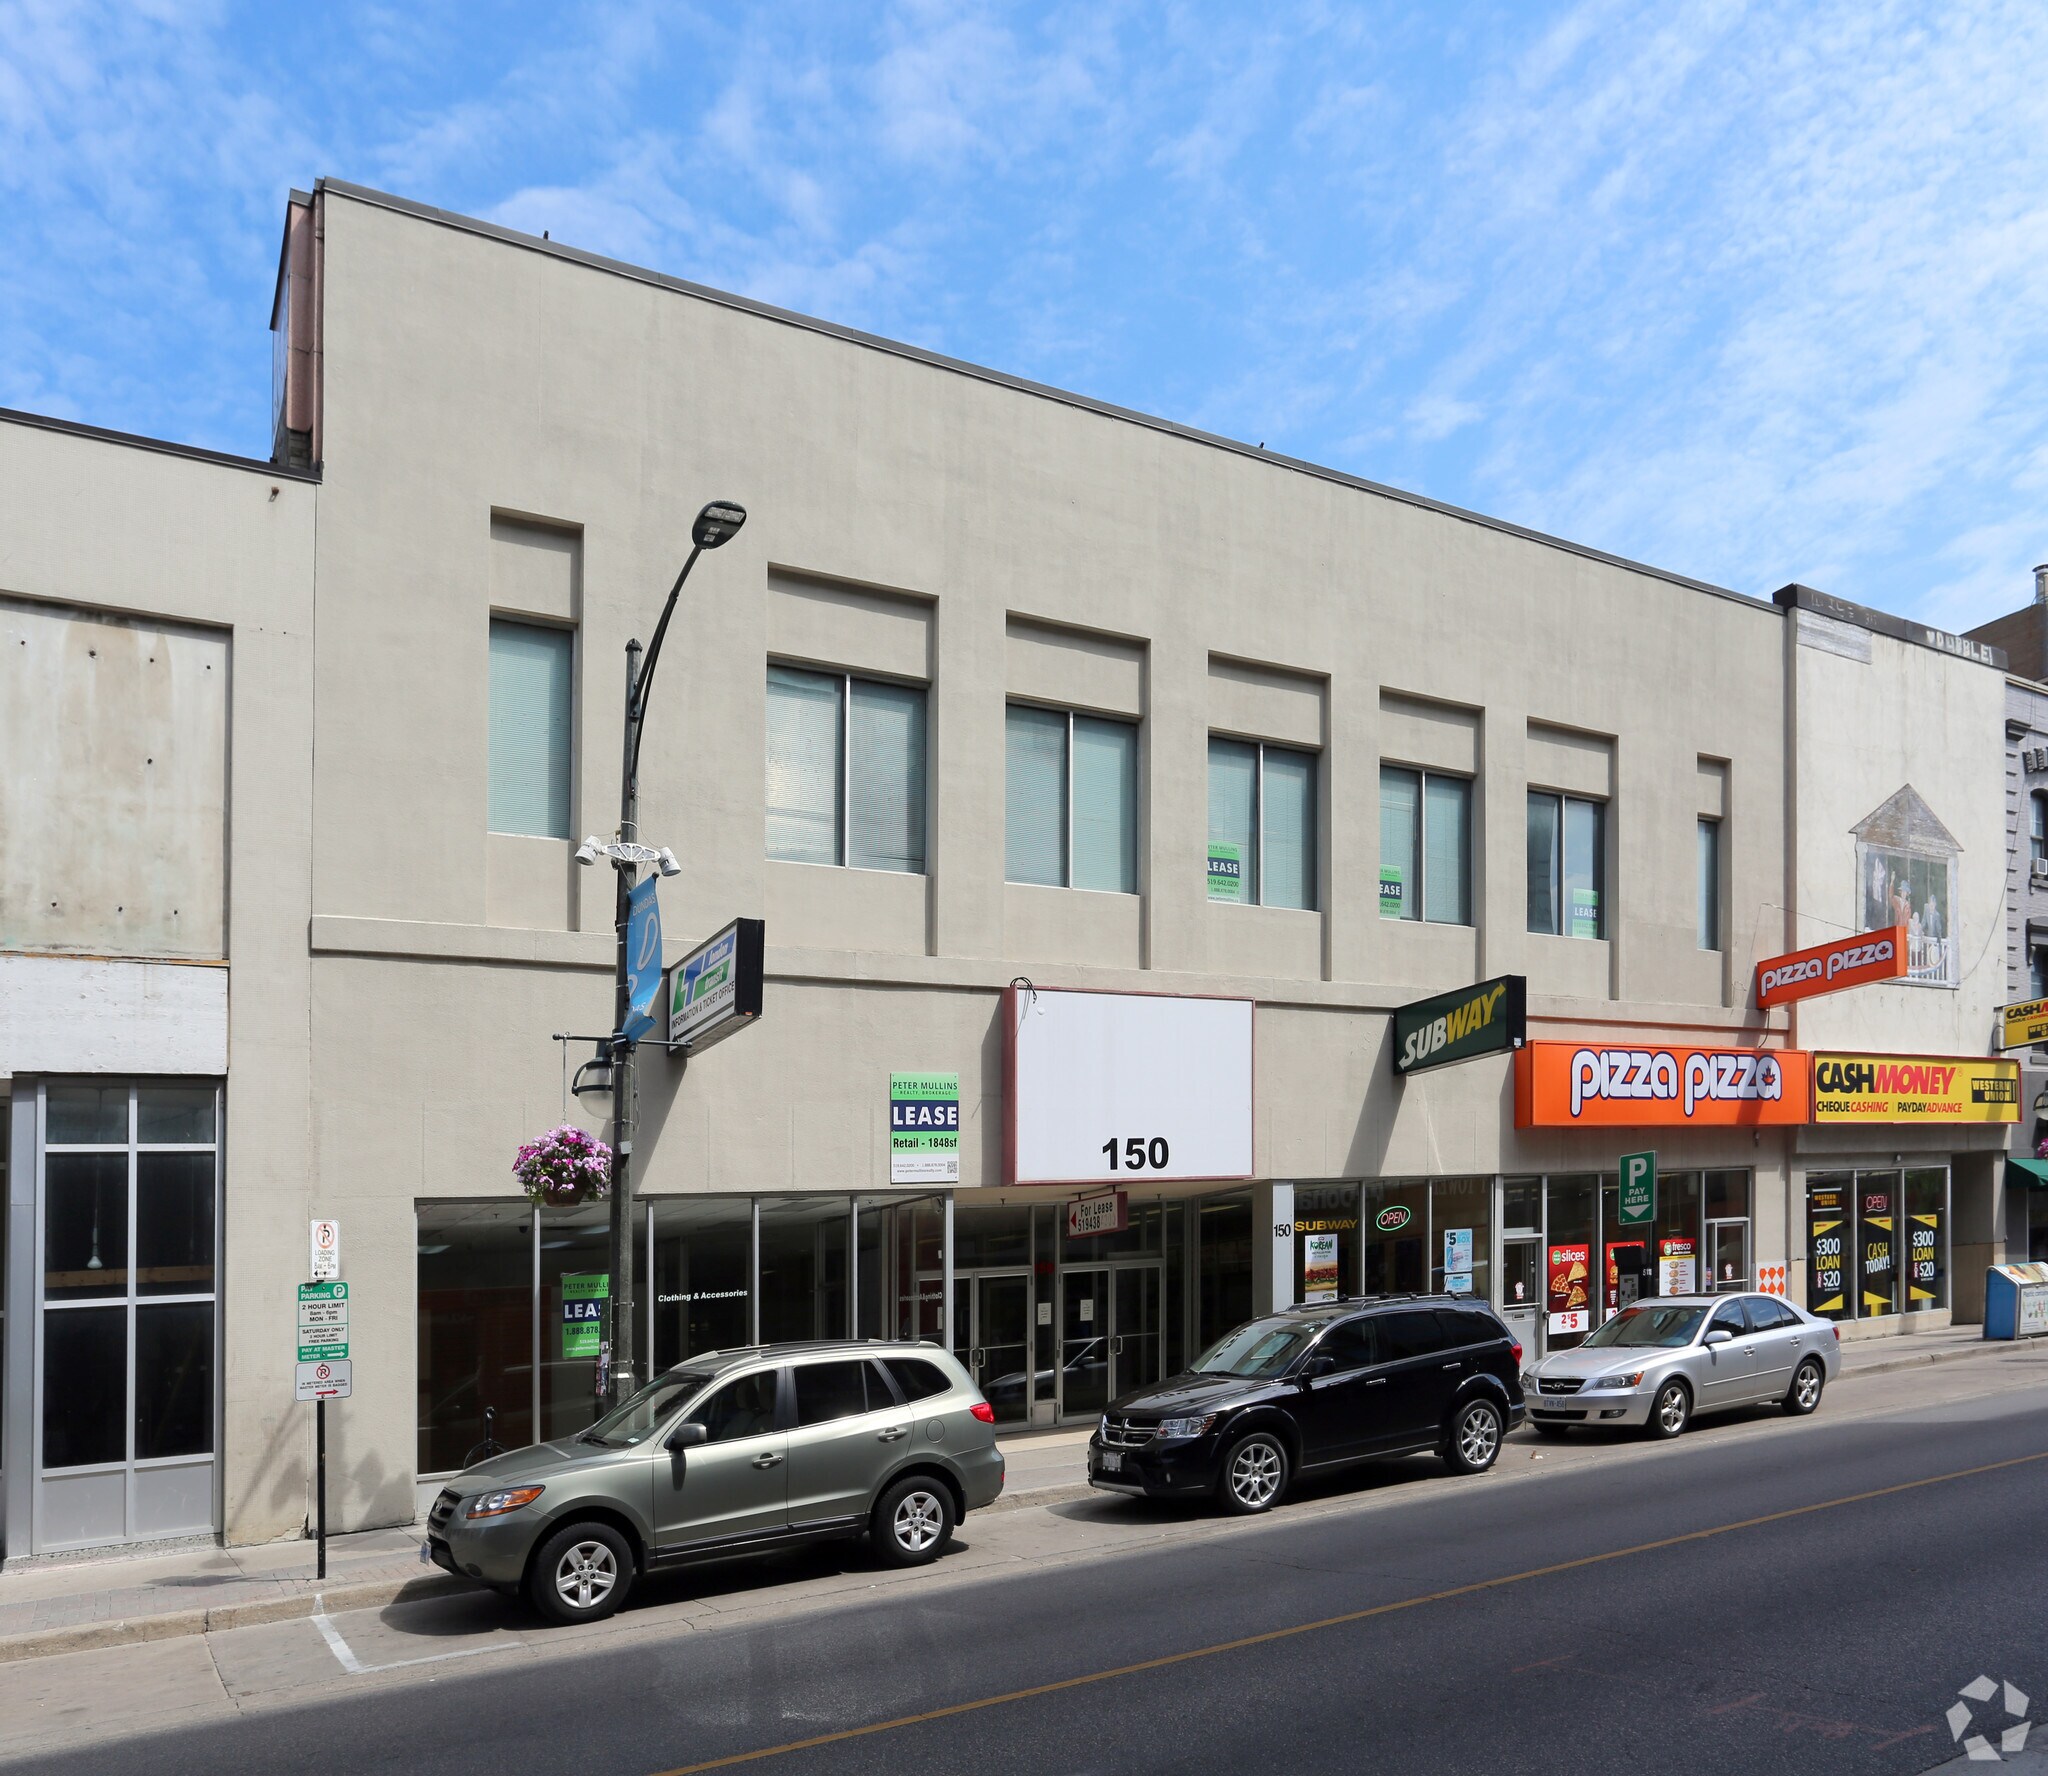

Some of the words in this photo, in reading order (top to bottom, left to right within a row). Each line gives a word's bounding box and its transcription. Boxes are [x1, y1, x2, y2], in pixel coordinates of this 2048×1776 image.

[1208, 861, 1238, 874] LEASE
[1574, 907, 1596, 918] LEASE
[1761, 958, 1823, 998] pizza
[1826, 940, 1894, 981] pizza
[672, 1004, 698, 1030] INFORMATION
[703, 991, 718, 1010] TICKET
[719, 980, 735, 1000] OFFICE
[1399, 982, 1506, 1070] SUBWAY
[892, 1082, 918, 1090] PETER
[920, 1082, 958, 1090] MULLINS
[1570, 1048, 1678, 1118] pizza
[1684, 1052, 1782, 1118] pizza
[1972, 1079, 2010, 1090] WESTERN
[1984, 1091, 2010, 1101] UNION
[893, 1106, 957, 1125] LEASE
[894, 1138, 918, 1148] Retail
[928, 1138, 957, 1148] 1848sf
[1102, 1138, 1170, 1170] 150
[1628, 1158, 1647, 1186] P
[1628, 1187, 1646, 1196] PAY
[1625, 1194, 1649, 1205] HERE
[1866, 1195, 1887, 1209] OPEN
[1080, 1204, 1091, 1217] For
[1094, 1202, 1113, 1215] Lease
[1380, 1211, 1406, 1225] OPEN
[1273, 1224, 1291, 1238] 150
[1294, 1220, 1358, 1232] SUBWAY
[1310, 1239, 1333, 1250] KOREAN
[1446, 1232, 1456, 1246] $5
[1912, 1230, 1934, 1247] $300
[1672, 1241, 1691, 1251] fresco
[1816, 1238, 1840, 1255] $300
[1868, 1242, 1888, 1260] CASH
[1561, 1250, 1586, 1262] slices
[1912, 1247, 1934, 1262] LOAN
[1816, 1256, 1840, 1270] LOAN
[1865, 1256, 1890, 1274] TODAY!
[1919, 1261, 1934, 1277] $20
[1823, 1271, 1840, 1287] $20
[658, 1294, 691, 1302] Clothing
[700, 1289, 748, 1300] Accessories
[1561, 1314, 1566, 1324] 2
